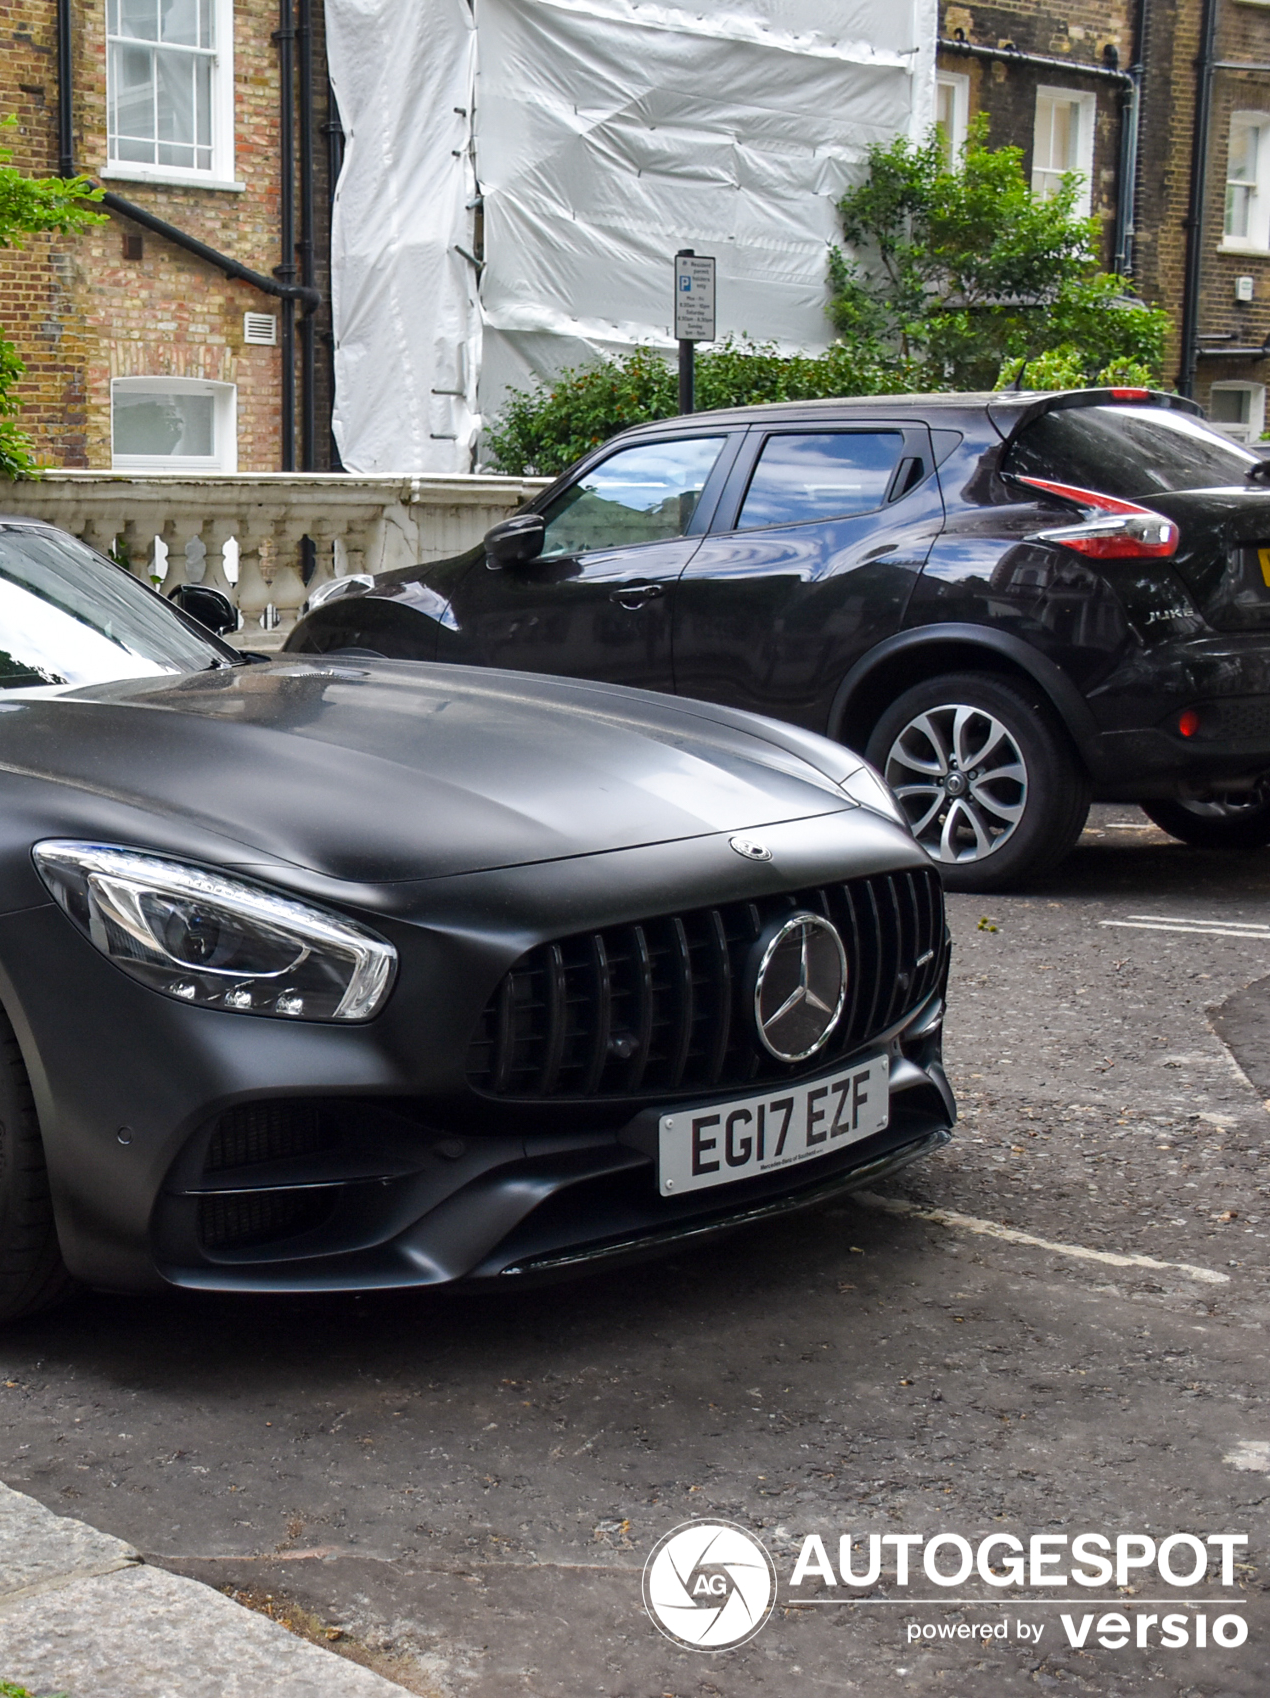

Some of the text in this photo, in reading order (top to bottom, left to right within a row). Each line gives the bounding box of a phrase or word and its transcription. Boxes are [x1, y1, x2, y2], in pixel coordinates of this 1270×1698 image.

[1144, 608, 1194, 625] JUKE
[692, 1069, 870, 1177] EG17 EZF
